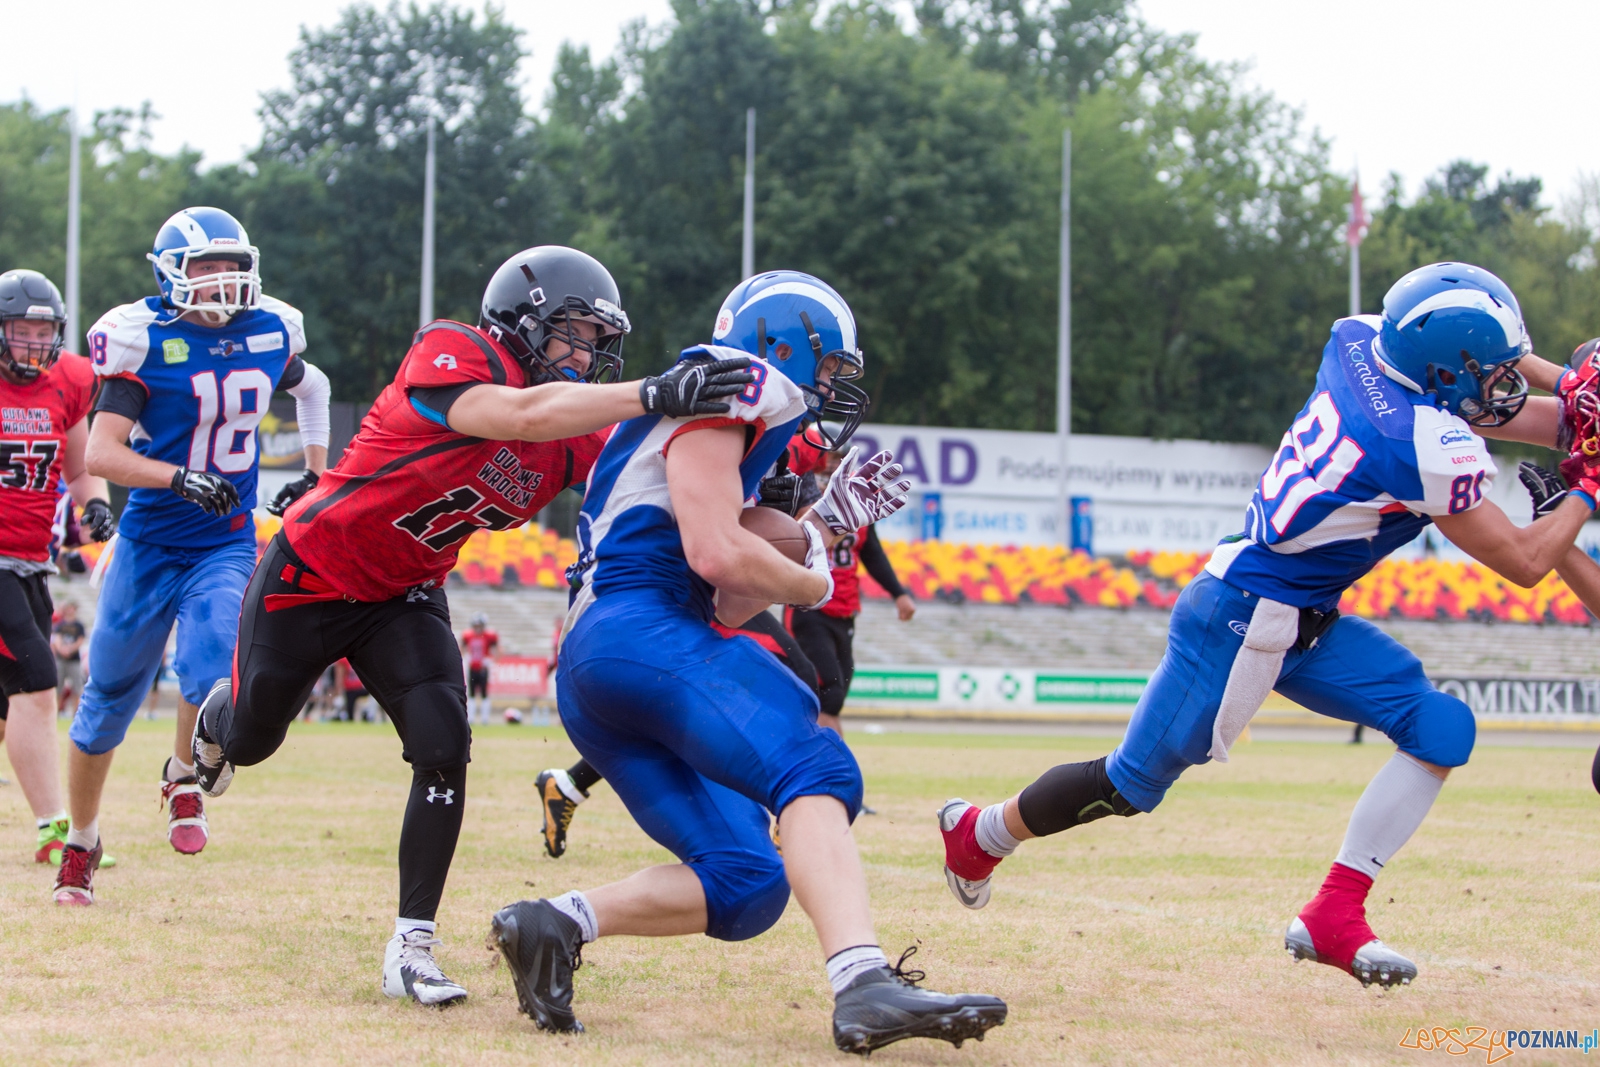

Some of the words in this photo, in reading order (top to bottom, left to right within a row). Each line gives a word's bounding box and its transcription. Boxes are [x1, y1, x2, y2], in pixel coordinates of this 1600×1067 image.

[718, 317, 729, 331] 56
[1346, 339, 1397, 418] kombinat
[1, 407, 50, 420] OUTLAWS
[2, 421, 53, 435] WROCLAW
[187, 367, 273, 474] 18
[0, 439, 60, 493] 57
[492, 446, 544, 490] OUTWS
[998, 456, 1163, 489] Podemujemy
[391, 484, 525, 553] 17
[953, 512, 1027, 532] GAMES
[1432, 679, 1576, 713] OMINKI
